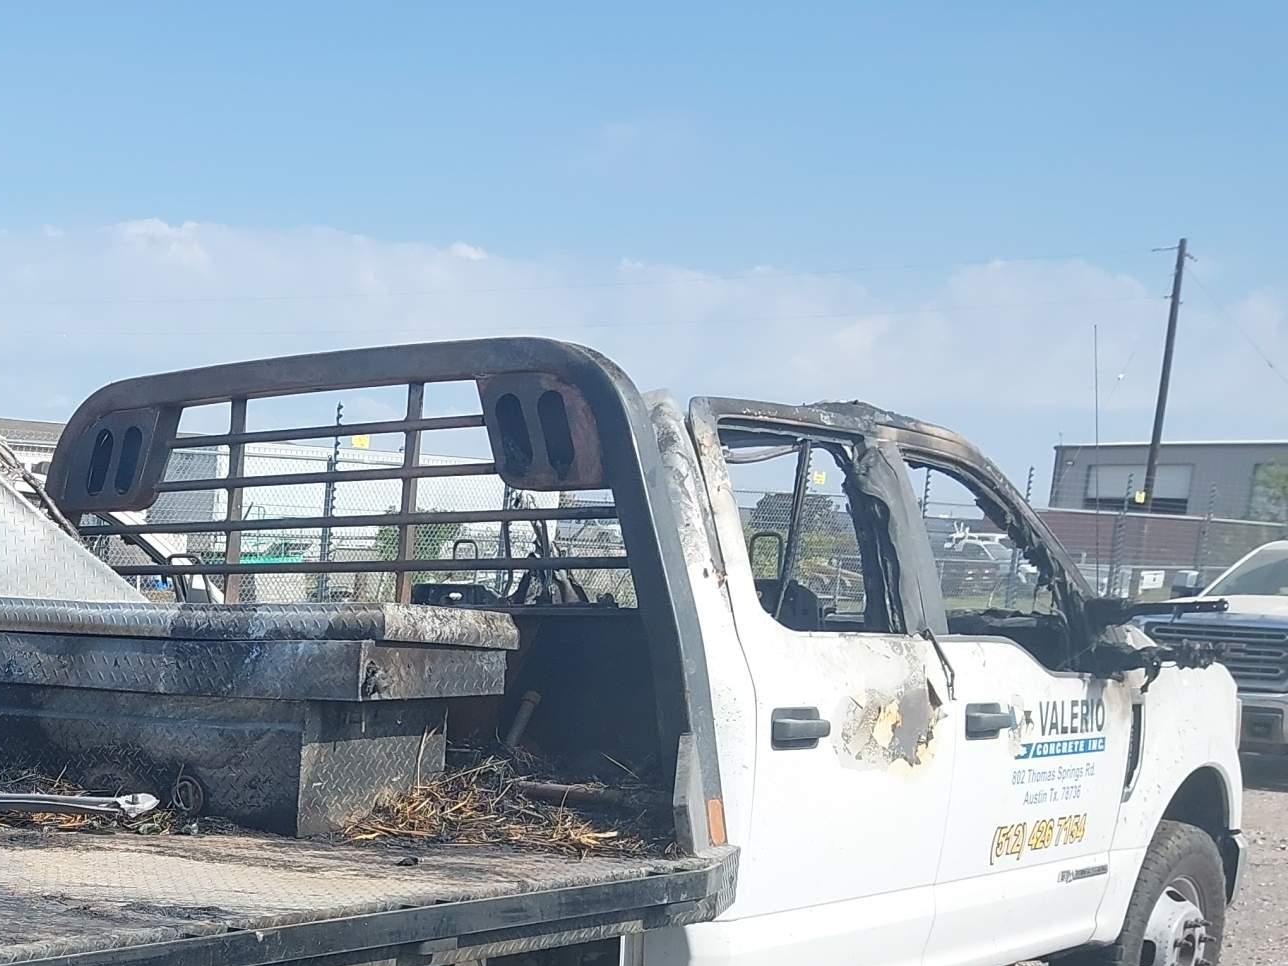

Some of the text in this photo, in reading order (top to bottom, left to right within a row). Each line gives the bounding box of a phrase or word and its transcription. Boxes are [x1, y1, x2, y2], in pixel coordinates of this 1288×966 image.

[1039, 698, 1106, 736] VALERIO
[1036, 741, 1085, 756] CONCRETE
[1027, 767, 1056, 783] Thomas
[1057, 765, 1084, 783] Springs
[1023, 790, 1048, 805] Austin
[990, 812, 1087, 865] (512) 426 7154
